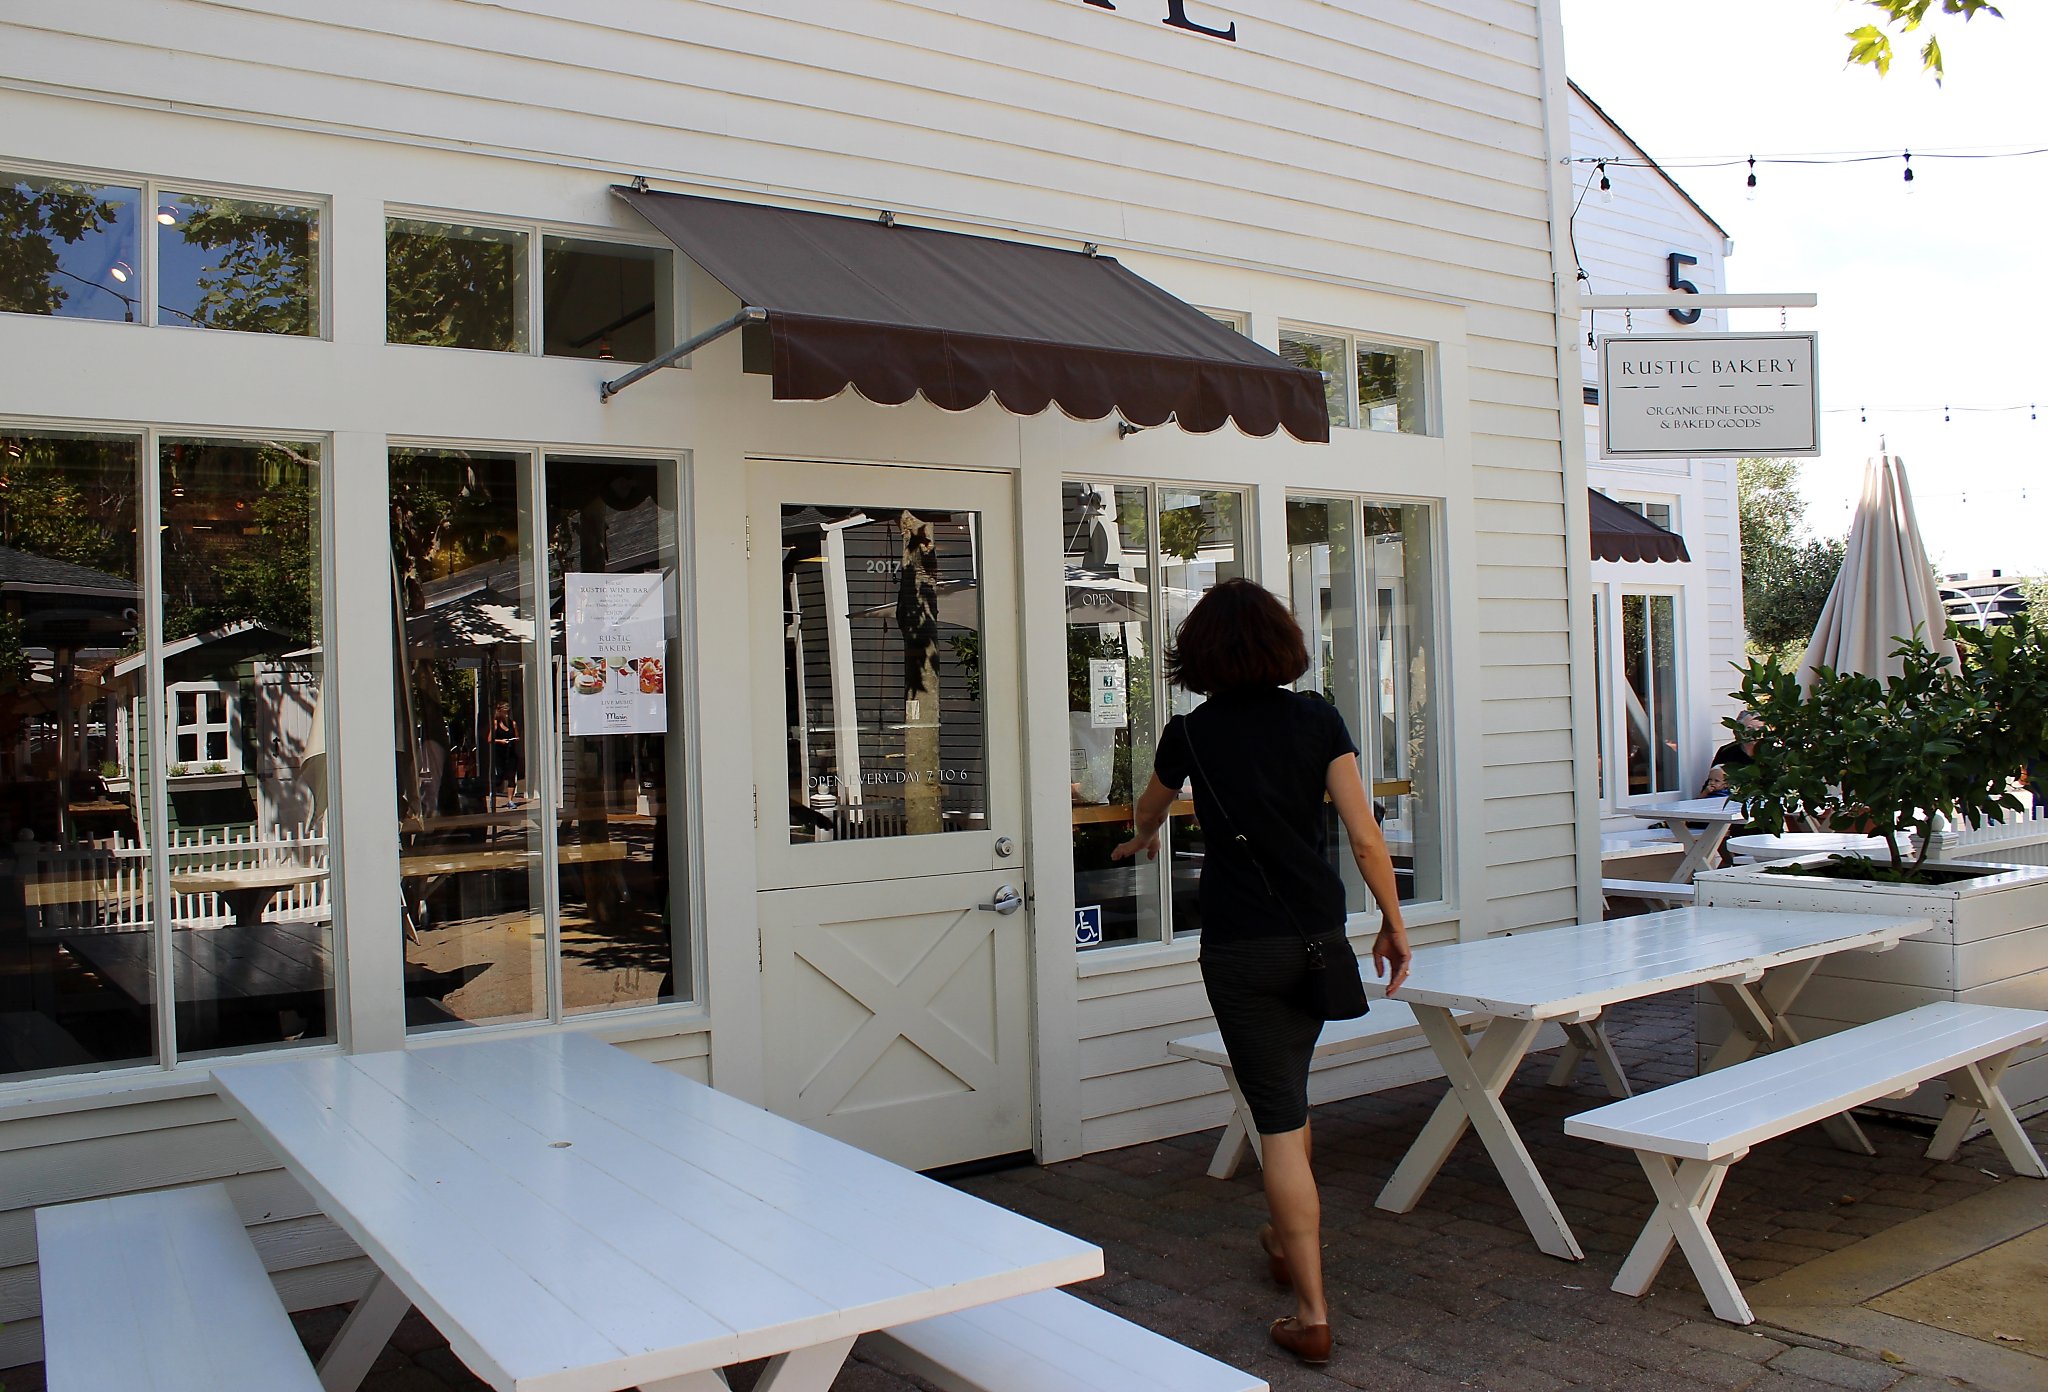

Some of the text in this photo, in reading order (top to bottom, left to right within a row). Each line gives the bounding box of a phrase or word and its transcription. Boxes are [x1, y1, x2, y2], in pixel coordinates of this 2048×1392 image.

[1667, 252, 1701, 325] 5
[1622, 358, 1798, 375] RUSTIC BAKERY
[1646, 404, 1775, 416] ORGANIC FINE FOODS
[1660, 418, 1761, 429] & BAKED GOODS
[866, 559, 901, 574] 2017
[1082, 593, 1114, 606] OPEN
[599, 634, 631, 642] RUSTIC
[605, 712, 628, 720] Marin
[807, 769, 968, 788] OPEN EVERY DAY 7 TO 6
